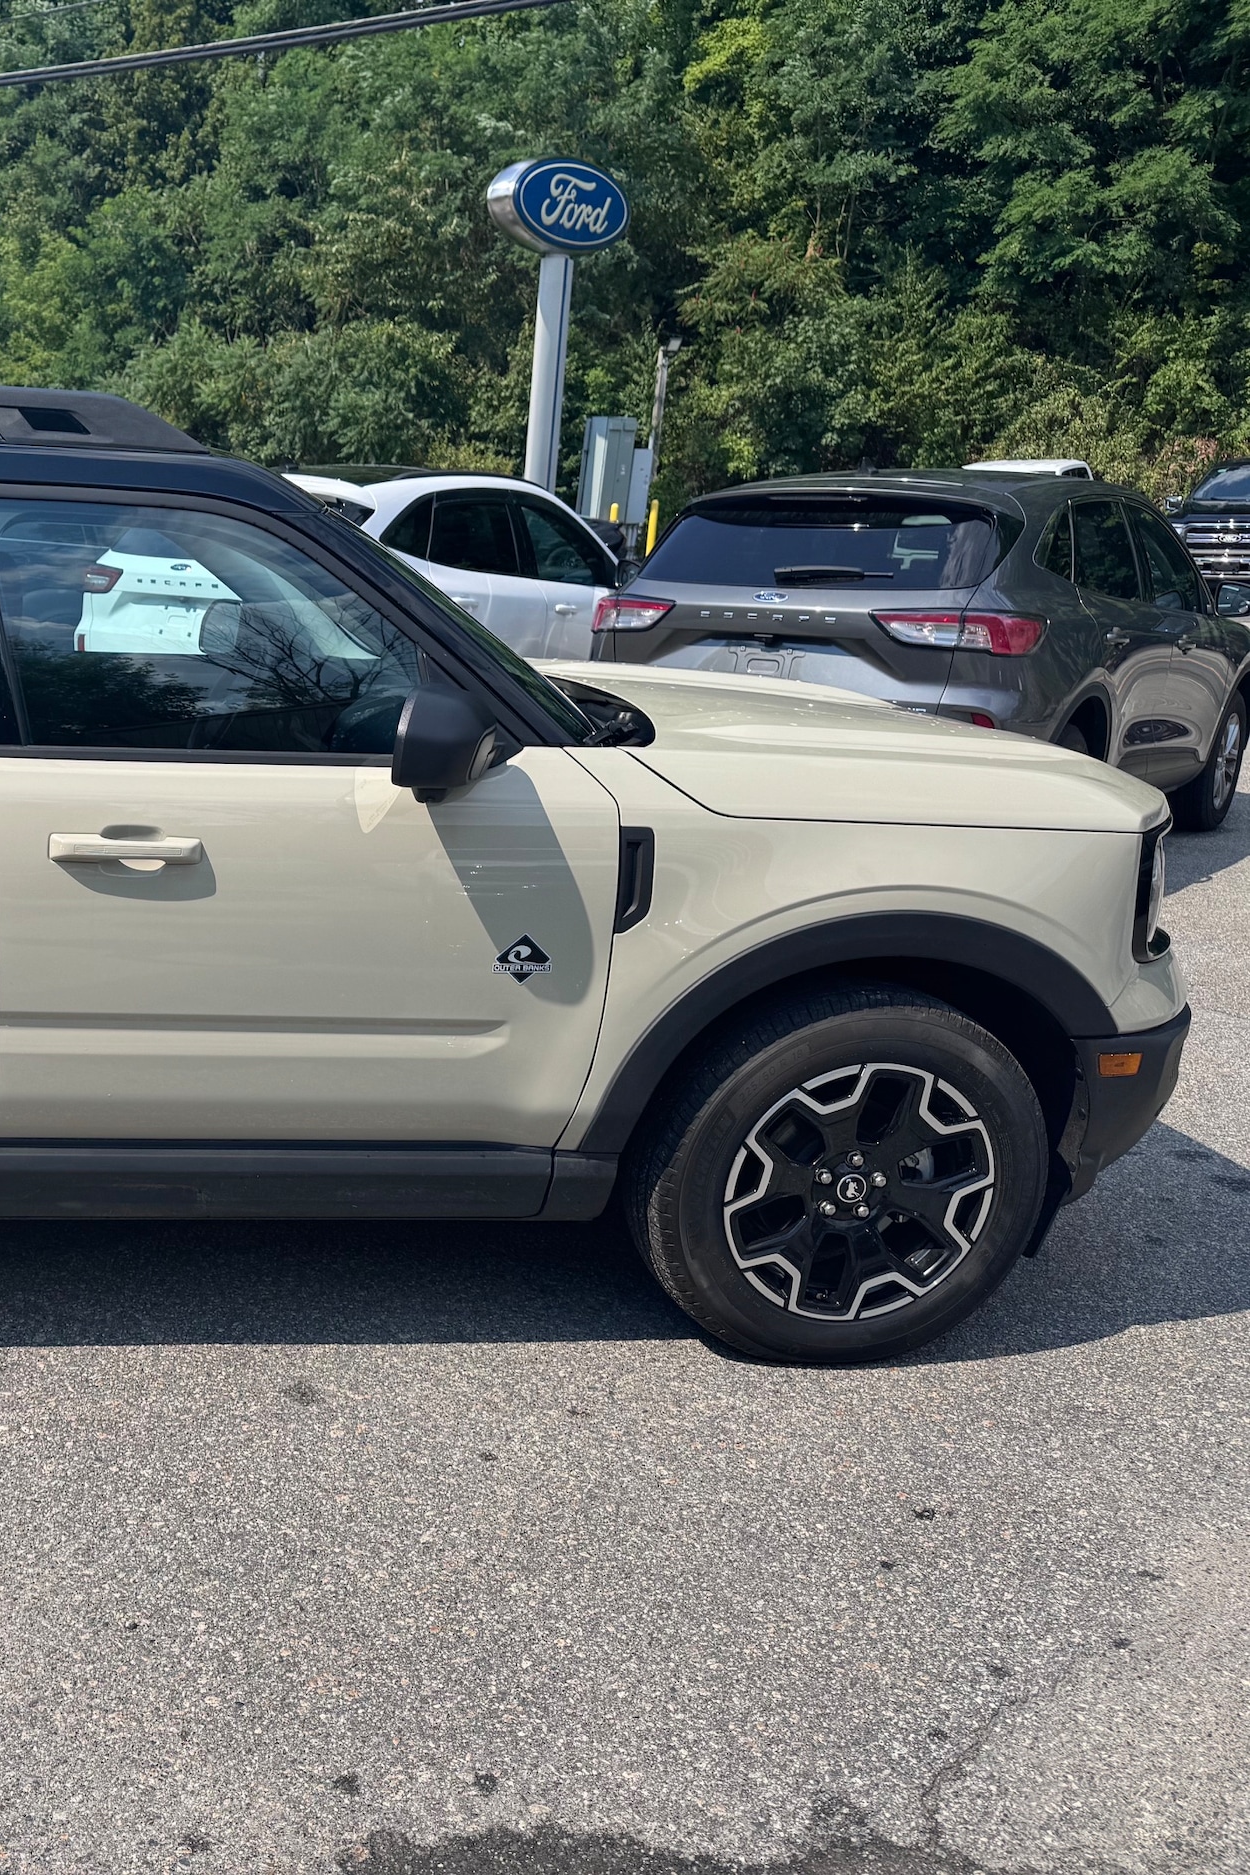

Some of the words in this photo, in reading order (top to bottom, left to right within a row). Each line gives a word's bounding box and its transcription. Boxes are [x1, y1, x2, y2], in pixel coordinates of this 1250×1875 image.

[540, 172, 613, 235] Ford
[699, 610, 837, 625] ESCAPE
[494, 964, 521, 972] OUTER
[522, 964, 550, 972] BANKS
